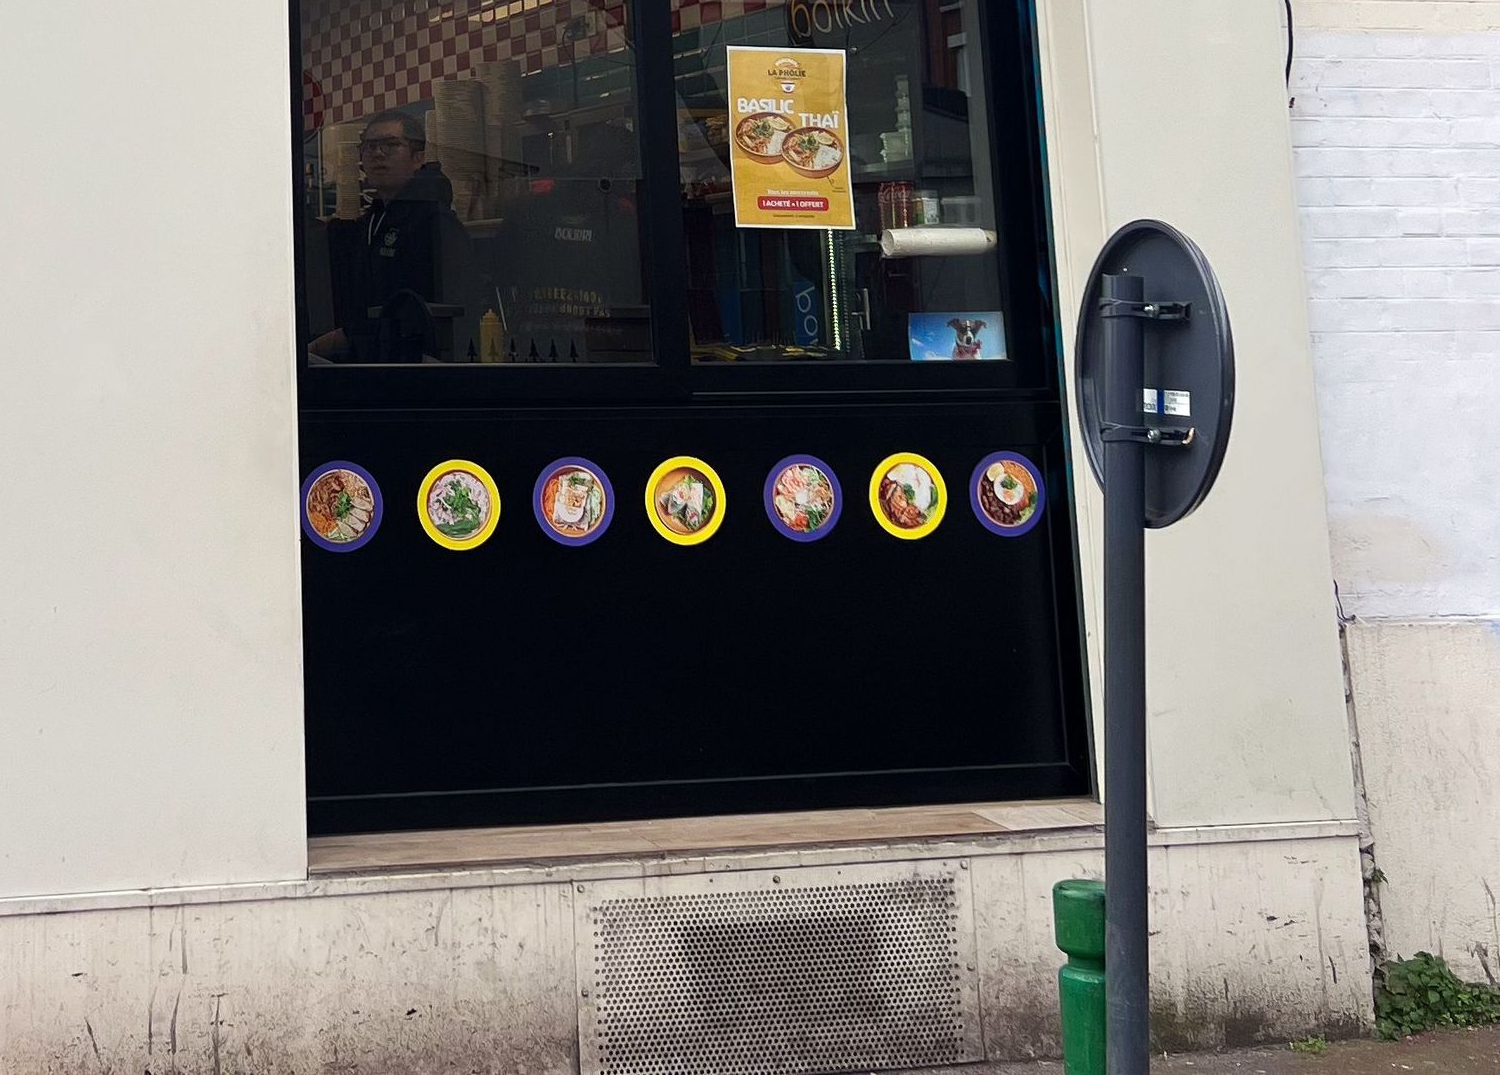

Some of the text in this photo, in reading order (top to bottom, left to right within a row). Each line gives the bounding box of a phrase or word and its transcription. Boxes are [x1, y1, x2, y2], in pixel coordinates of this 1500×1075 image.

[778, 69, 807, 77] PHOLIE
[737, 97, 794, 115] BASILIC
[798, 110, 839, 130] THAÏ
